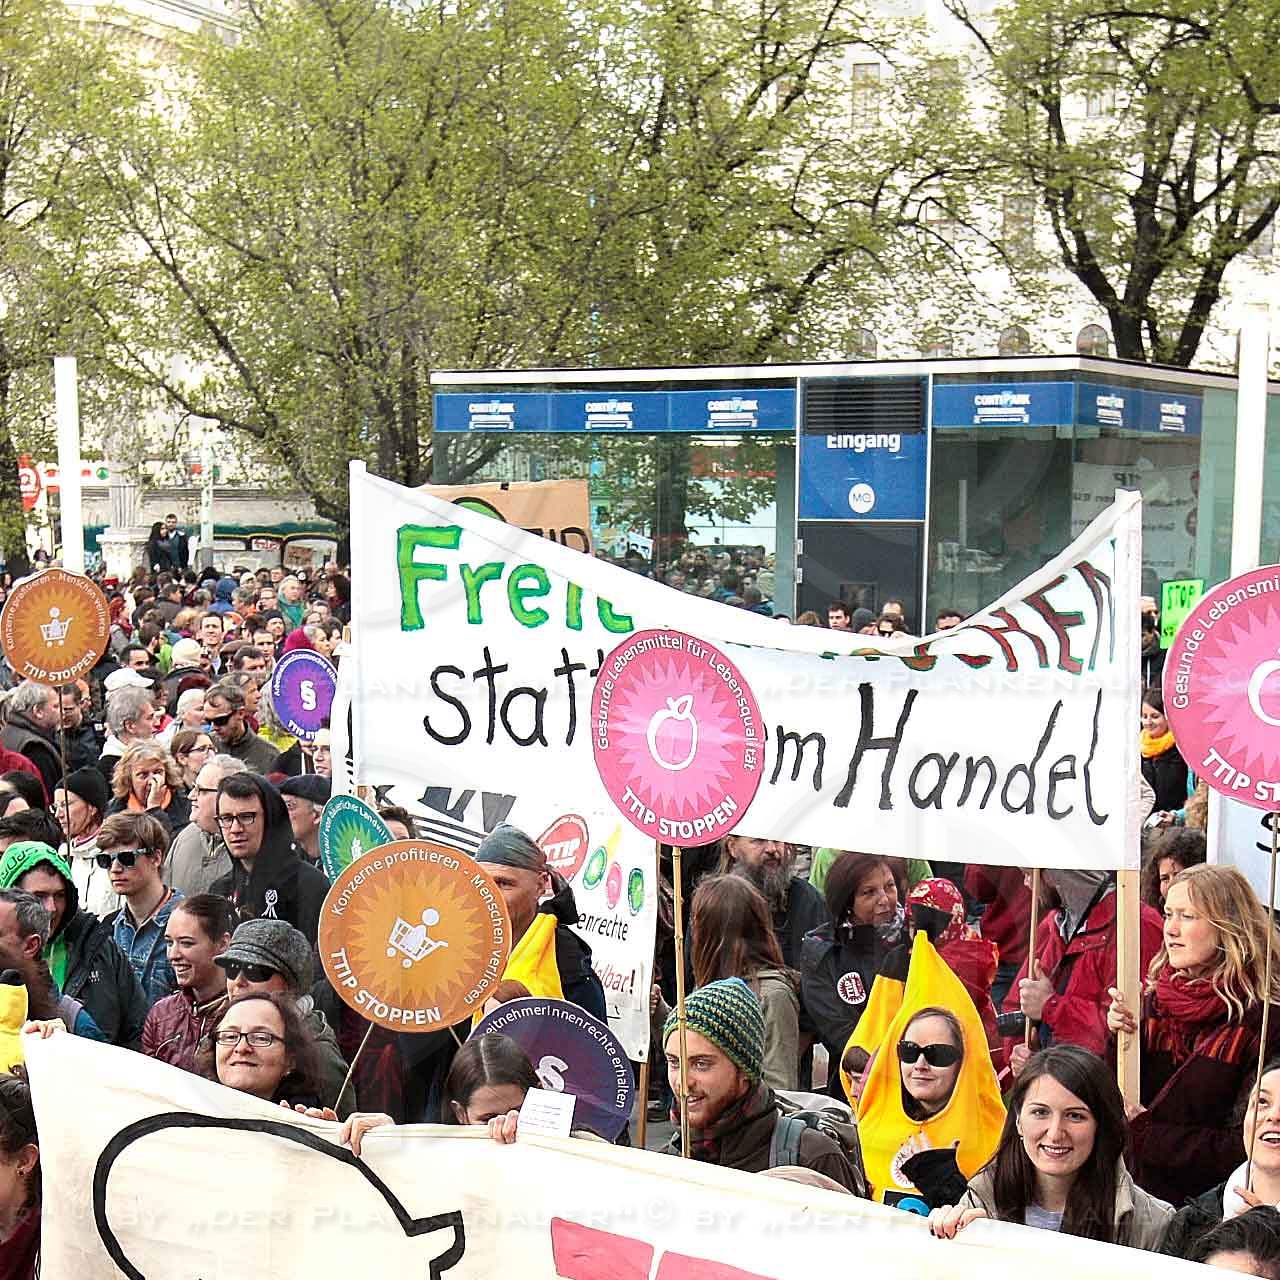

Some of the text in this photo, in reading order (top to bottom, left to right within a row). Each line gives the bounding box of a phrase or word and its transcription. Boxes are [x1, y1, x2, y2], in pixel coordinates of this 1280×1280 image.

[826, 434, 901, 454] Eingang
[23, 649, 97, 682] TTIP STOPPEN
[1172, 629, 1205, 709] Gesunde
[423, 646, 606, 748] stat
[835, 682, 1109, 827] Handel
[597, 635, 760, 771] Gesunde Lebensmittel für Lebensqualität
[1201, 747, 1251, 792] TTIP
[621, 785, 739, 839] TTIP STOPPEN
[330, 847, 504, 1006] Konzerne profitieren Menschen verlieren
[330, 946, 442, 1026] TTIP STOPPEN
[611, 1057, 630, 1109] erhalten
